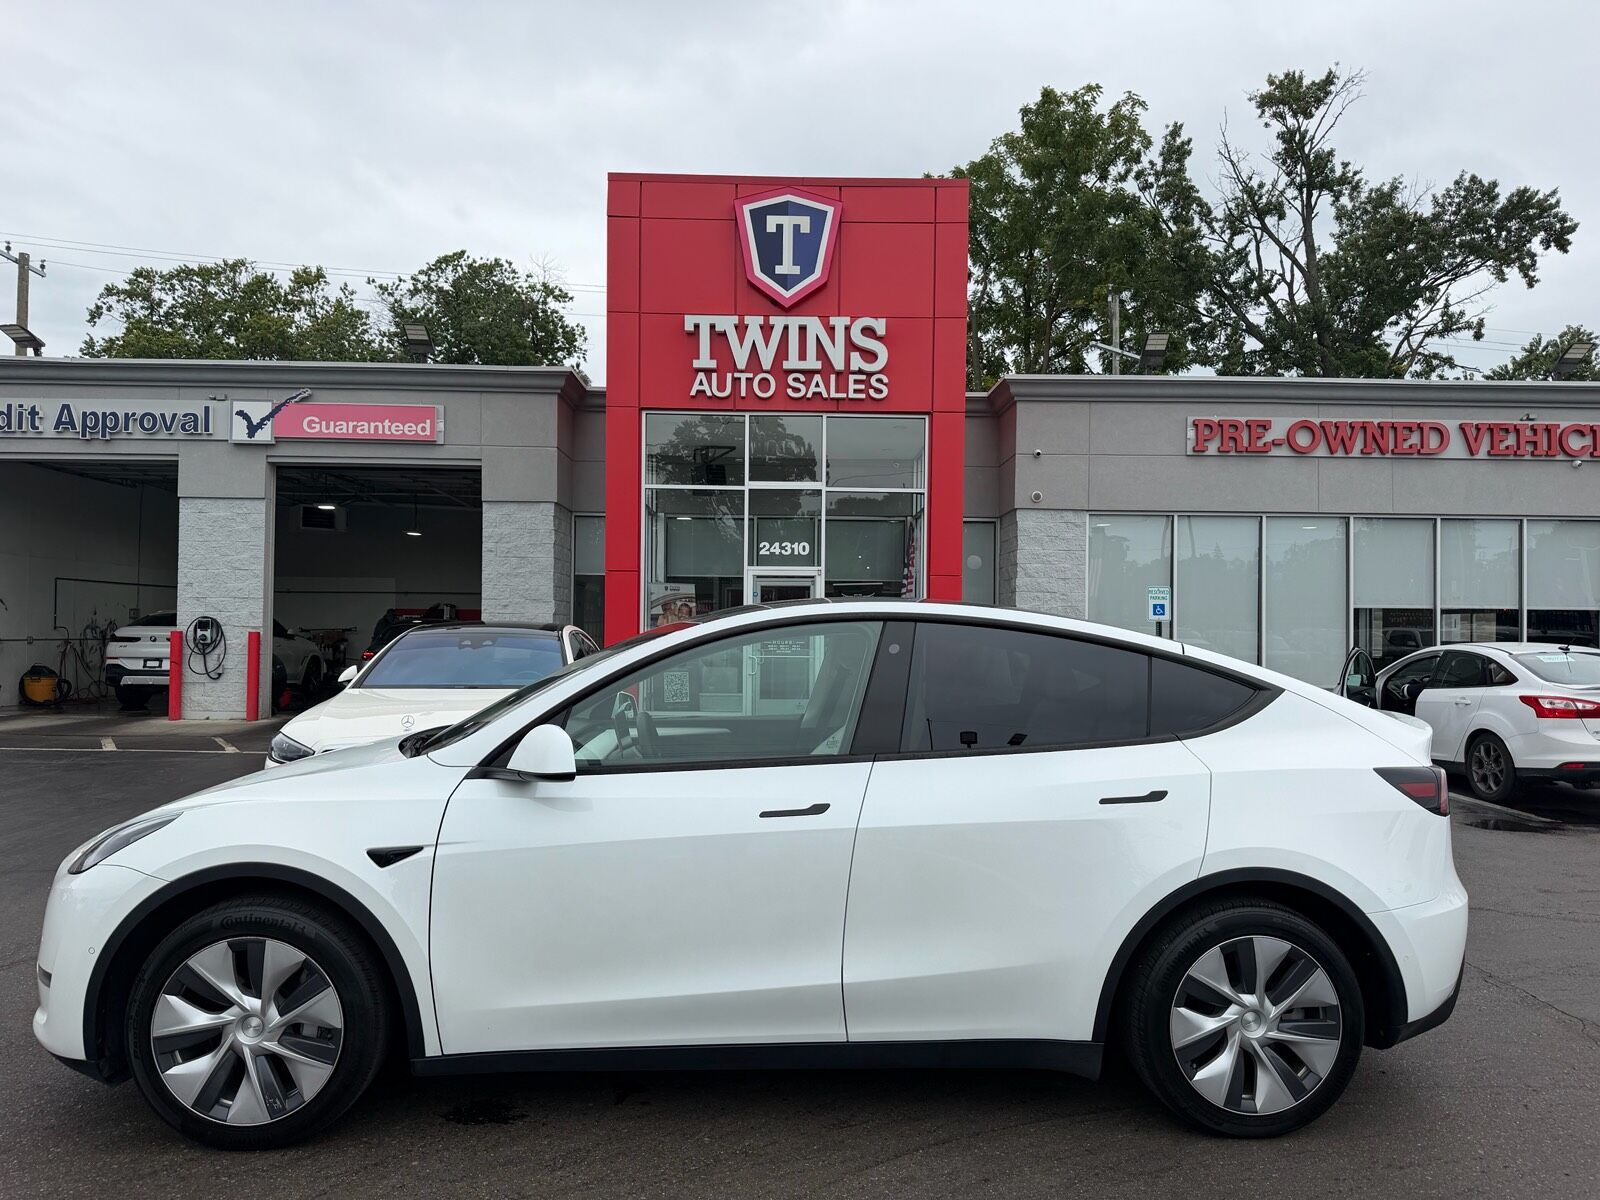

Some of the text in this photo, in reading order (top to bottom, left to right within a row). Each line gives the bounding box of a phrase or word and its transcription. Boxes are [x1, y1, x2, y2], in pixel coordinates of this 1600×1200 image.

[766, 215, 810, 275] T
[685, 315, 889, 373] TWINS
[690, 372, 889, 400] AUTO SALES
[0, 402, 213, 439] dit Approval
[302, 416, 431, 436] Guaranteed
[1193, 418, 1450, 456] PRE-OWNED
[759, 541, 810, 556] 24310
